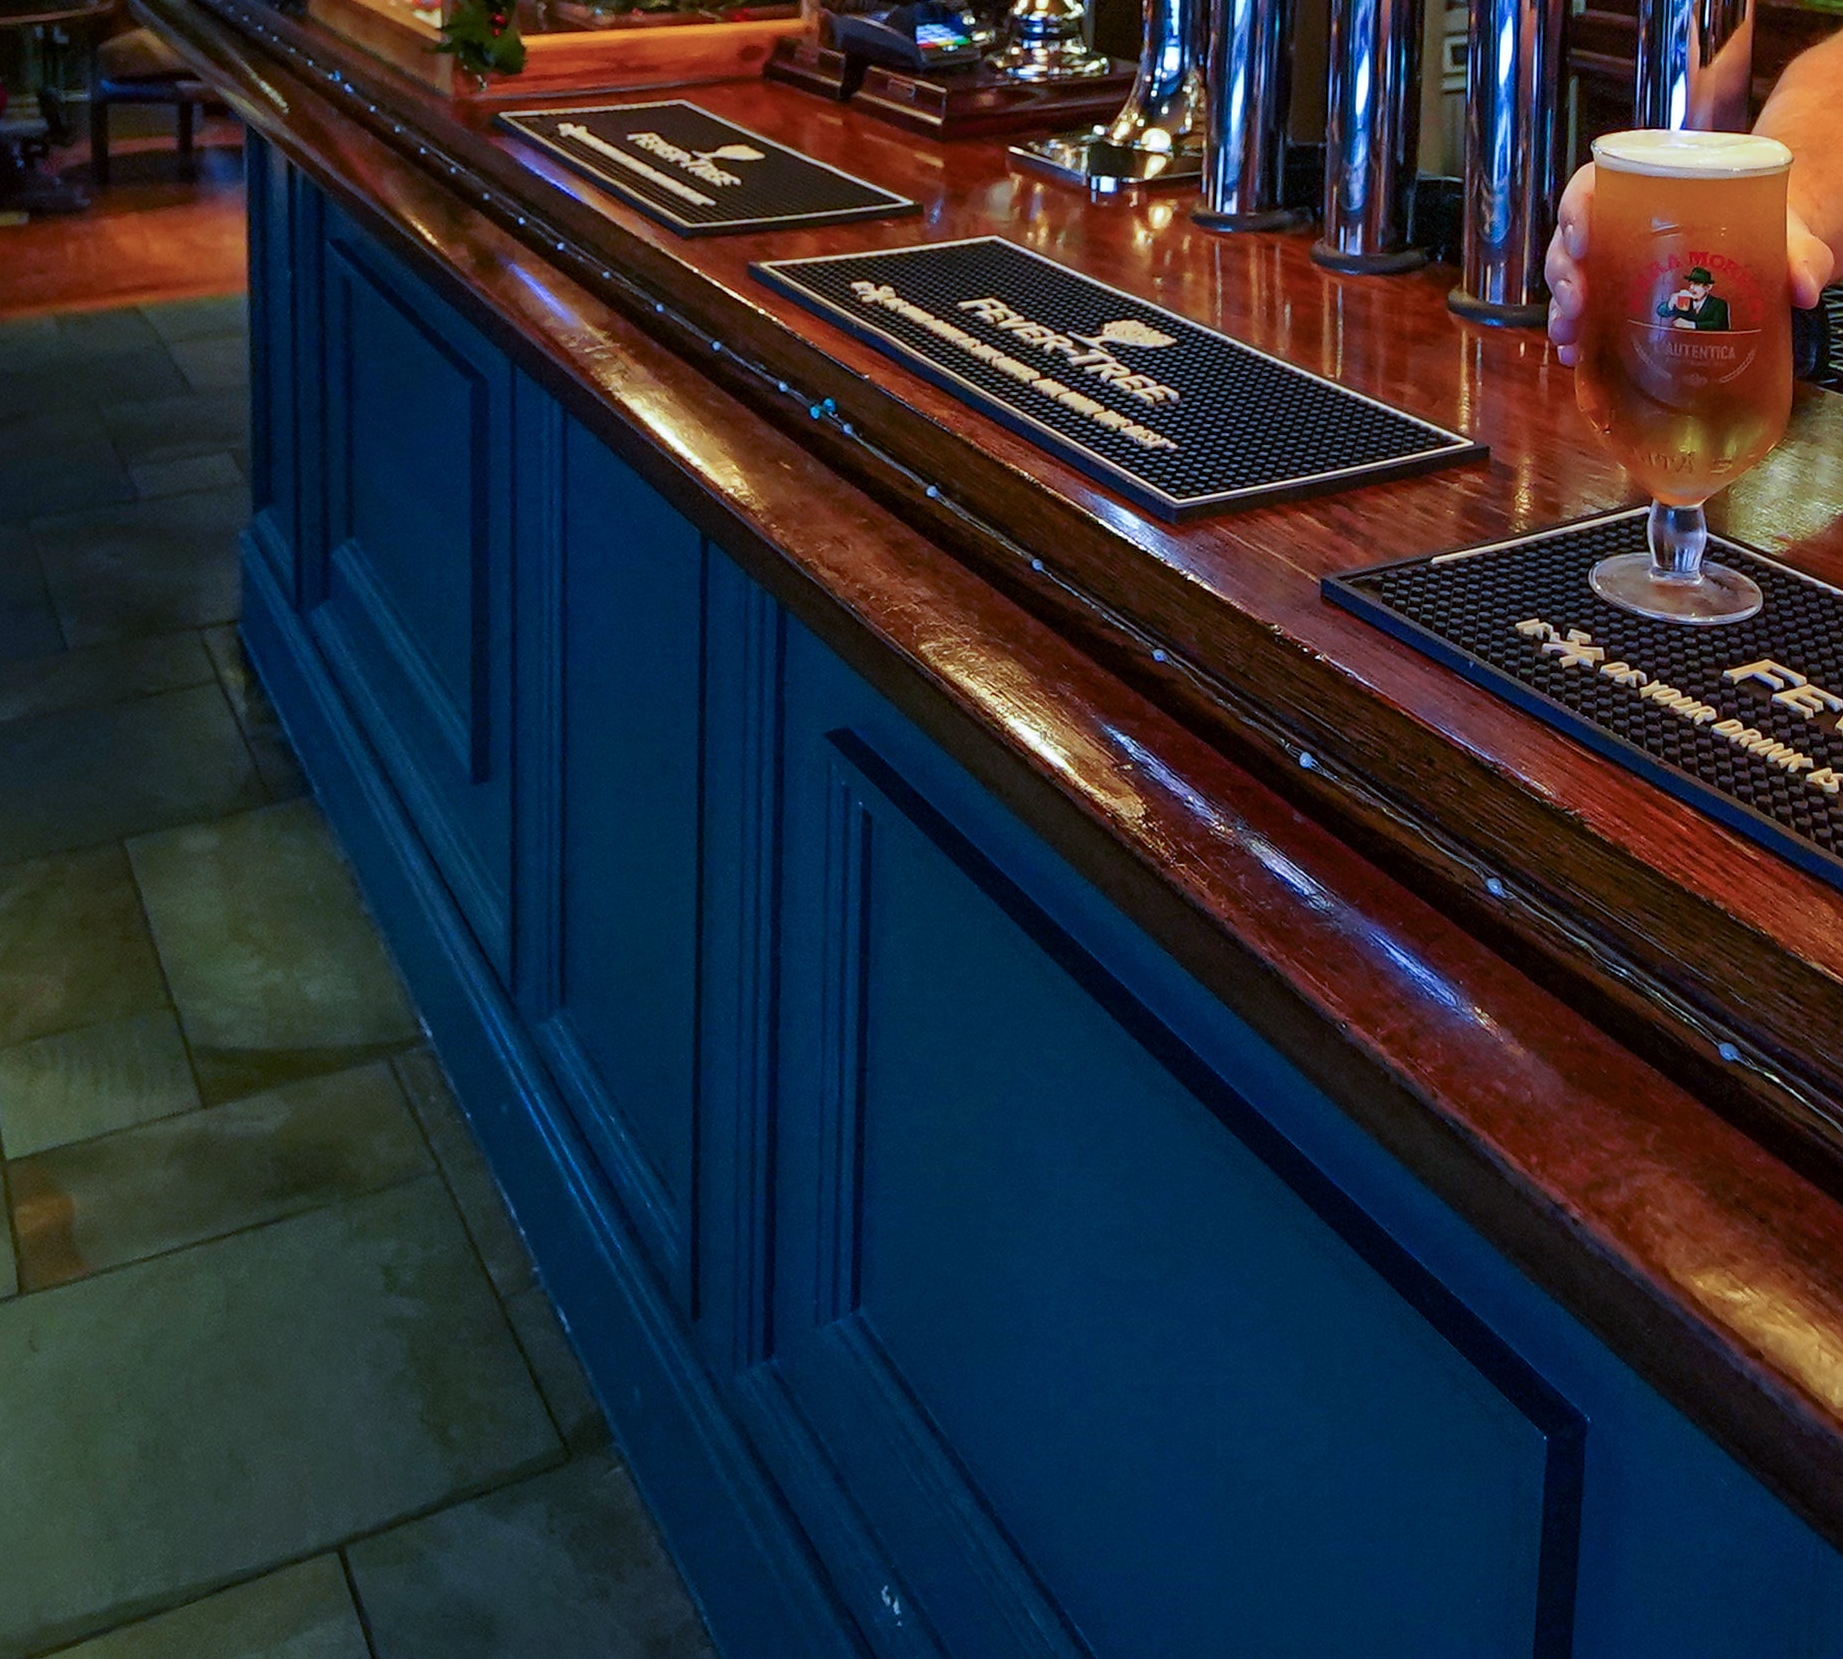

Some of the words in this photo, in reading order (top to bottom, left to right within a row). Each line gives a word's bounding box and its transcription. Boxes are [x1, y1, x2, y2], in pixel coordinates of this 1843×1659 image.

[957, 296, 1182, 407] FEVER-TREE
[1598, 660, 1648, 689] OF
[1639, 679, 1718, 726] YOUR
[1710, 717, 1815, 774] DRINK
